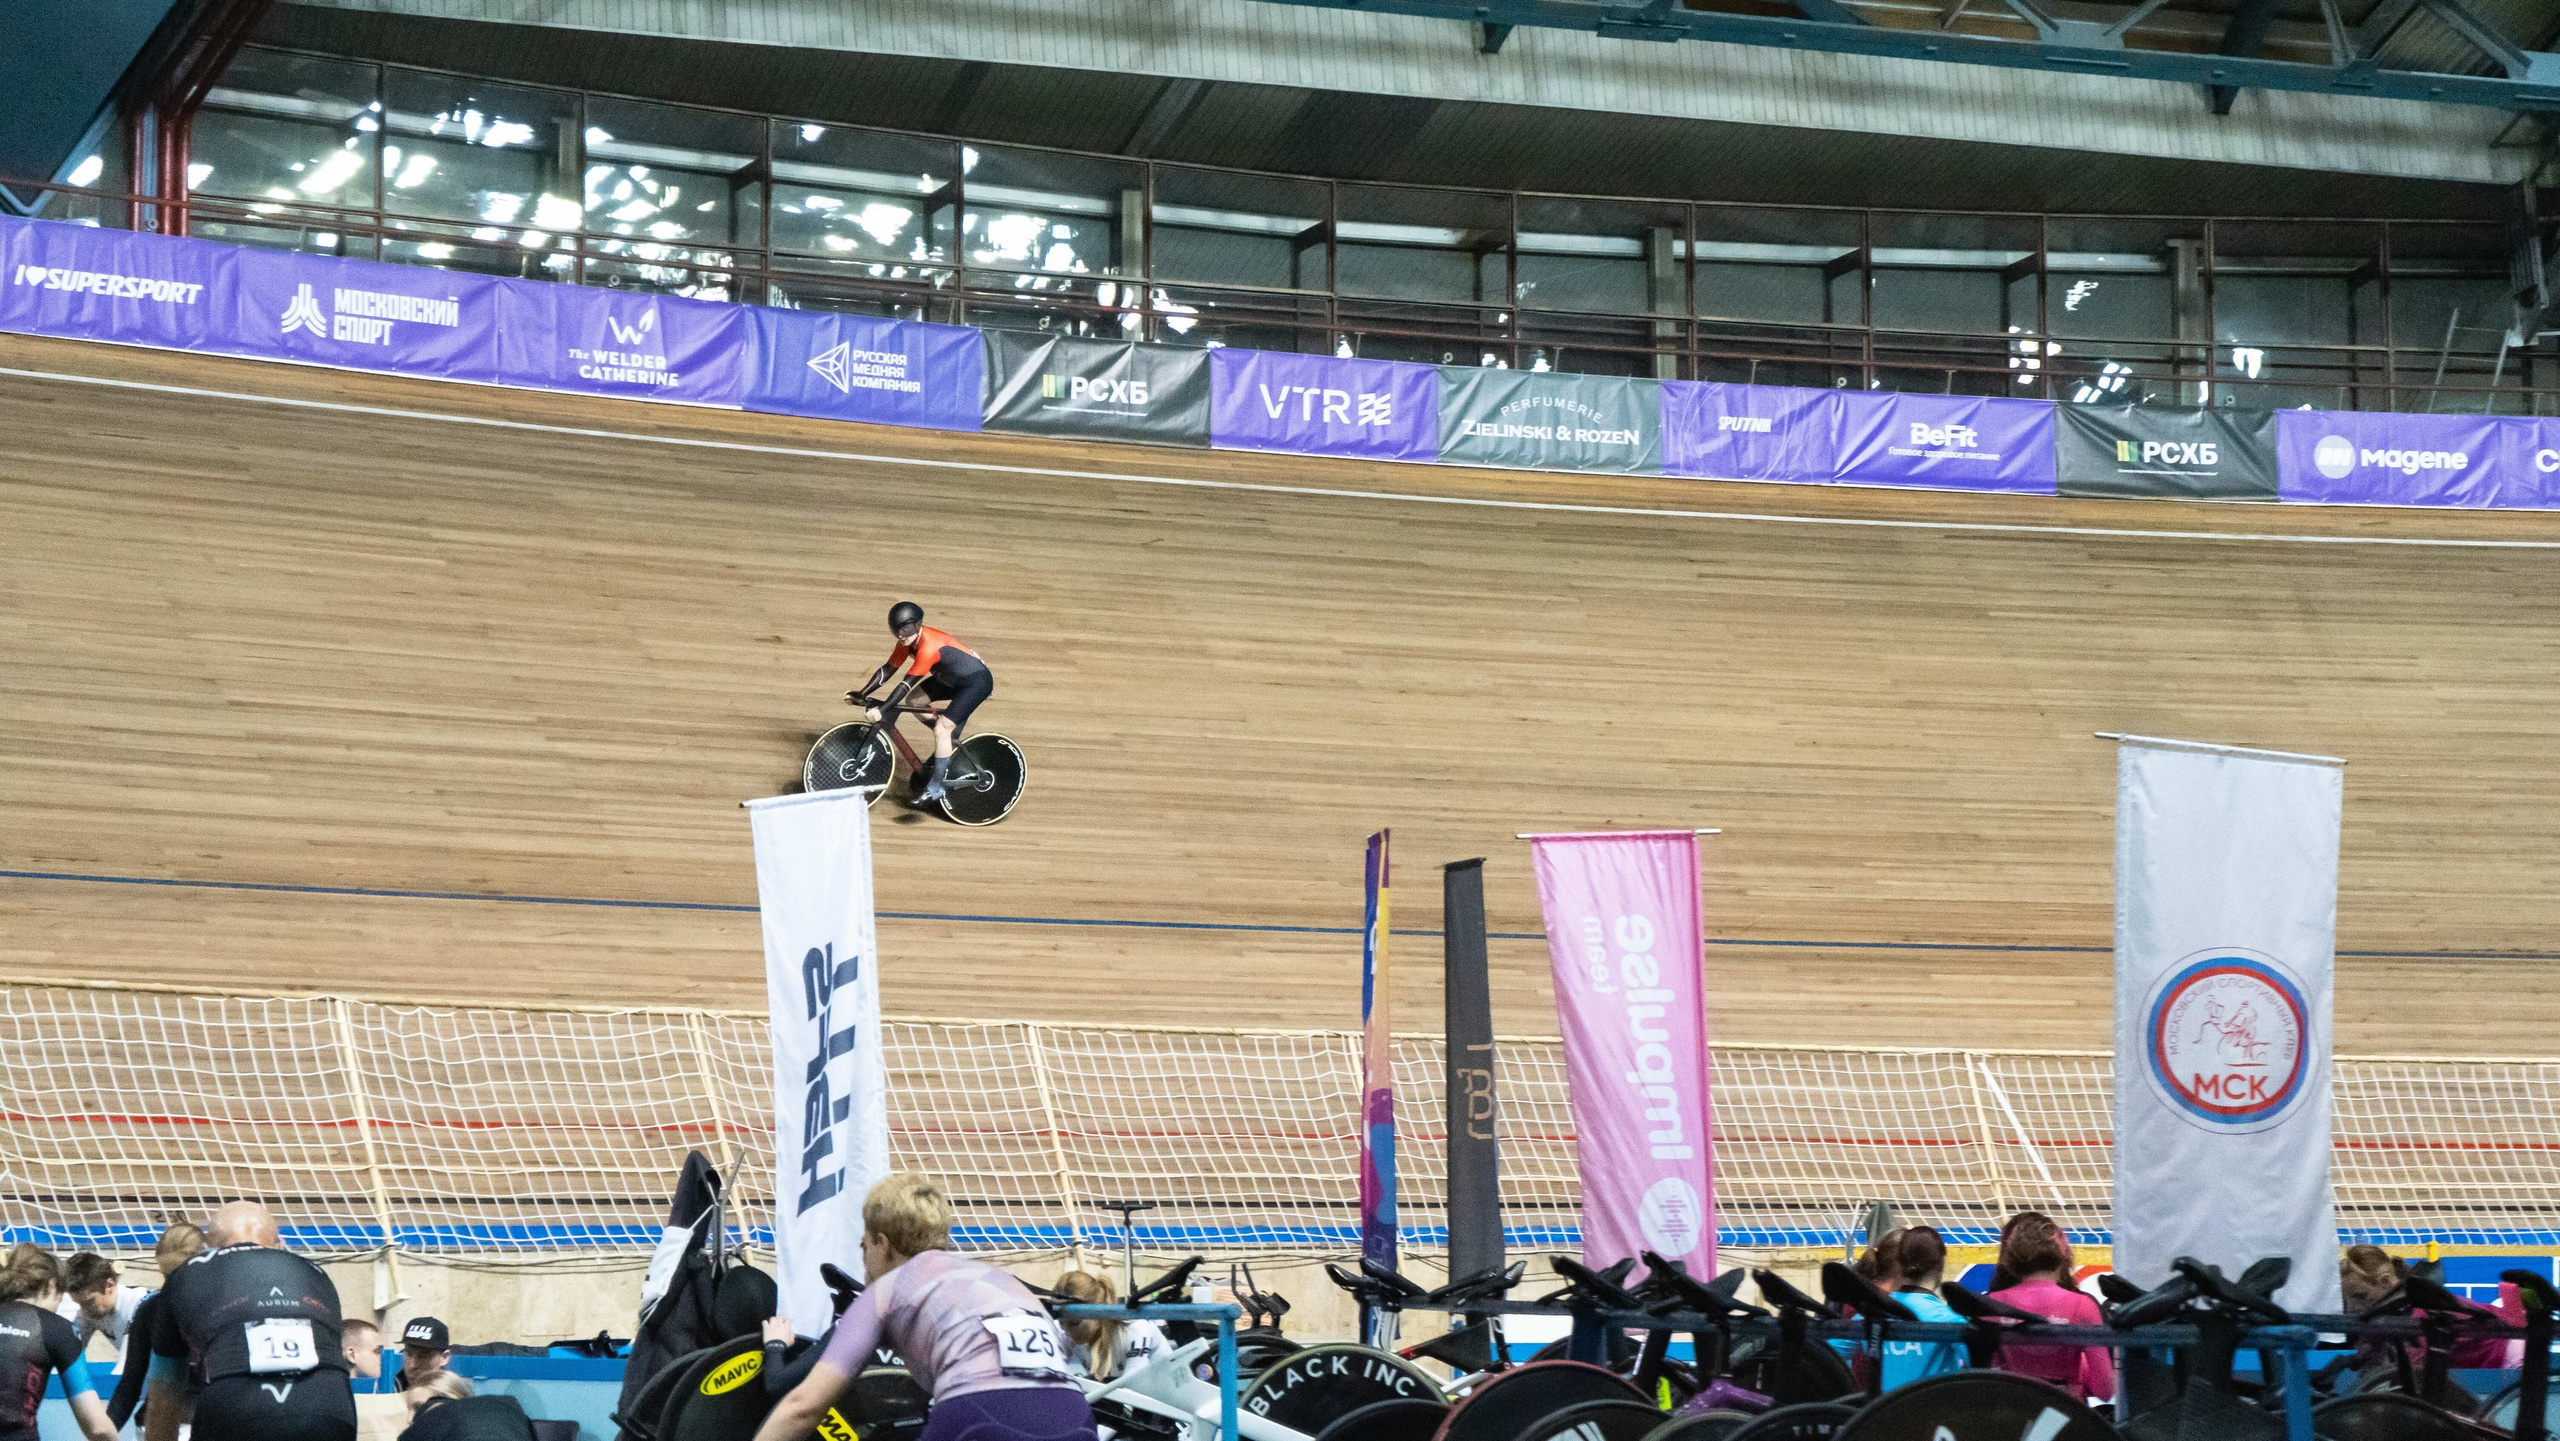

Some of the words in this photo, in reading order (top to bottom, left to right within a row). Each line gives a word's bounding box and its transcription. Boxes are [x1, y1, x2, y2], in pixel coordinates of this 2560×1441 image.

[44, 267, 203, 306] SUPERSPORT
[334, 287, 459, 328] МОСКОВСКИЙ
[333, 319, 394, 346] СПОРТ
[568, 348, 591, 361] The
[592, 350, 667, 370] WELDER
[852, 350, 908, 366] РУССКАЯ
[852, 362, 906, 379] МЕДНАЯ
[579, 364, 680, 388] CATHERINE
[852, 375, 921, 393] КОМПАНИЯ
[1070, 376, 1150, 405] РСХБ
[1259, 383, 1351, 425] VTR
[1500, 396, 1604, 426] PERFUMERIE
[1462, 419, 1553, 440] ZIELINSKI
[1555, 425, 1571, 442] &
[1575, 429, 1641, 446] ROZEN
[1910, 421, 1979, 448] BeFit
[2143, 441, 2219, 465] РСХБ
[2360, 448, 2470, 476] Magene
[2193, 1072, 2268, 1101] МСК
[264, 1337, 300, 1358] 19
[1005, 1328, 1055, 1357] 125
[713, 1358, 758, 1389] MAVIC
[1249, 1356, 1349, 1416] BLACK
[1363, 1359, 1416, 1396] INC
